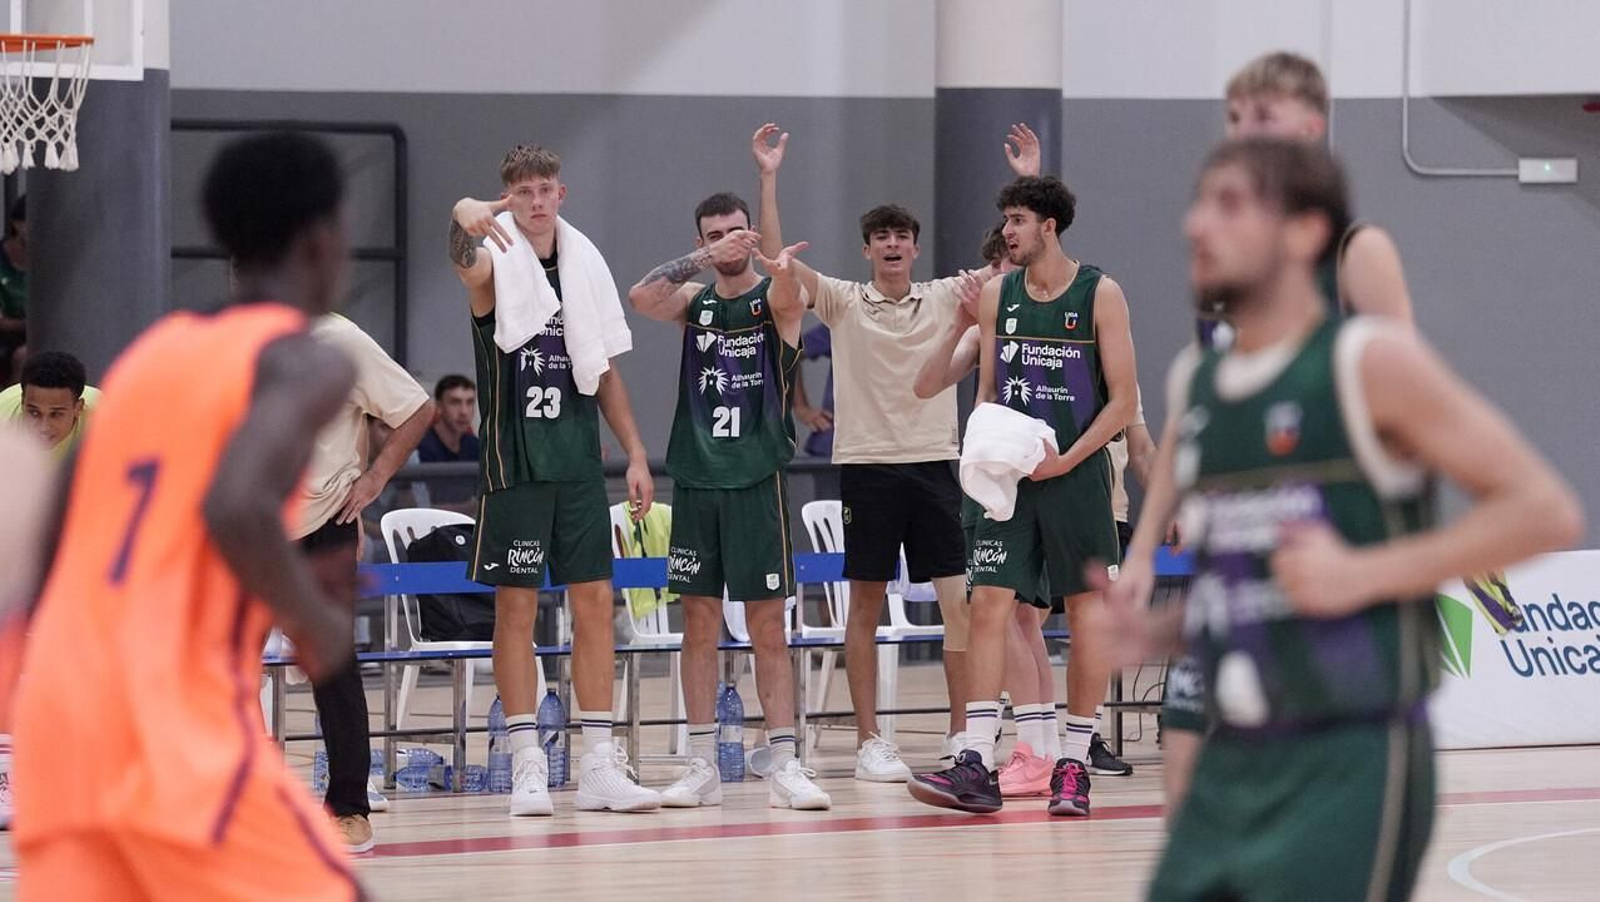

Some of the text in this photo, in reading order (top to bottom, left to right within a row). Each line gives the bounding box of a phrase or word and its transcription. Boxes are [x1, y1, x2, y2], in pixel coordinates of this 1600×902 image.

[717, 332, 764, 347] Fundació
[718, 345, 757, 359] Unicaja
[1021, 343, 1081, 359] Fundación
[1021, 354, 1063, 370] Unicaja
[525, 386, 562, 419] 23
[1035, 392, 1046, 400] de
[1053, 393, 1076, 402] Torre
[712, 406, 741, 438] 21
[1500, 634, 1600, 678] Unica
